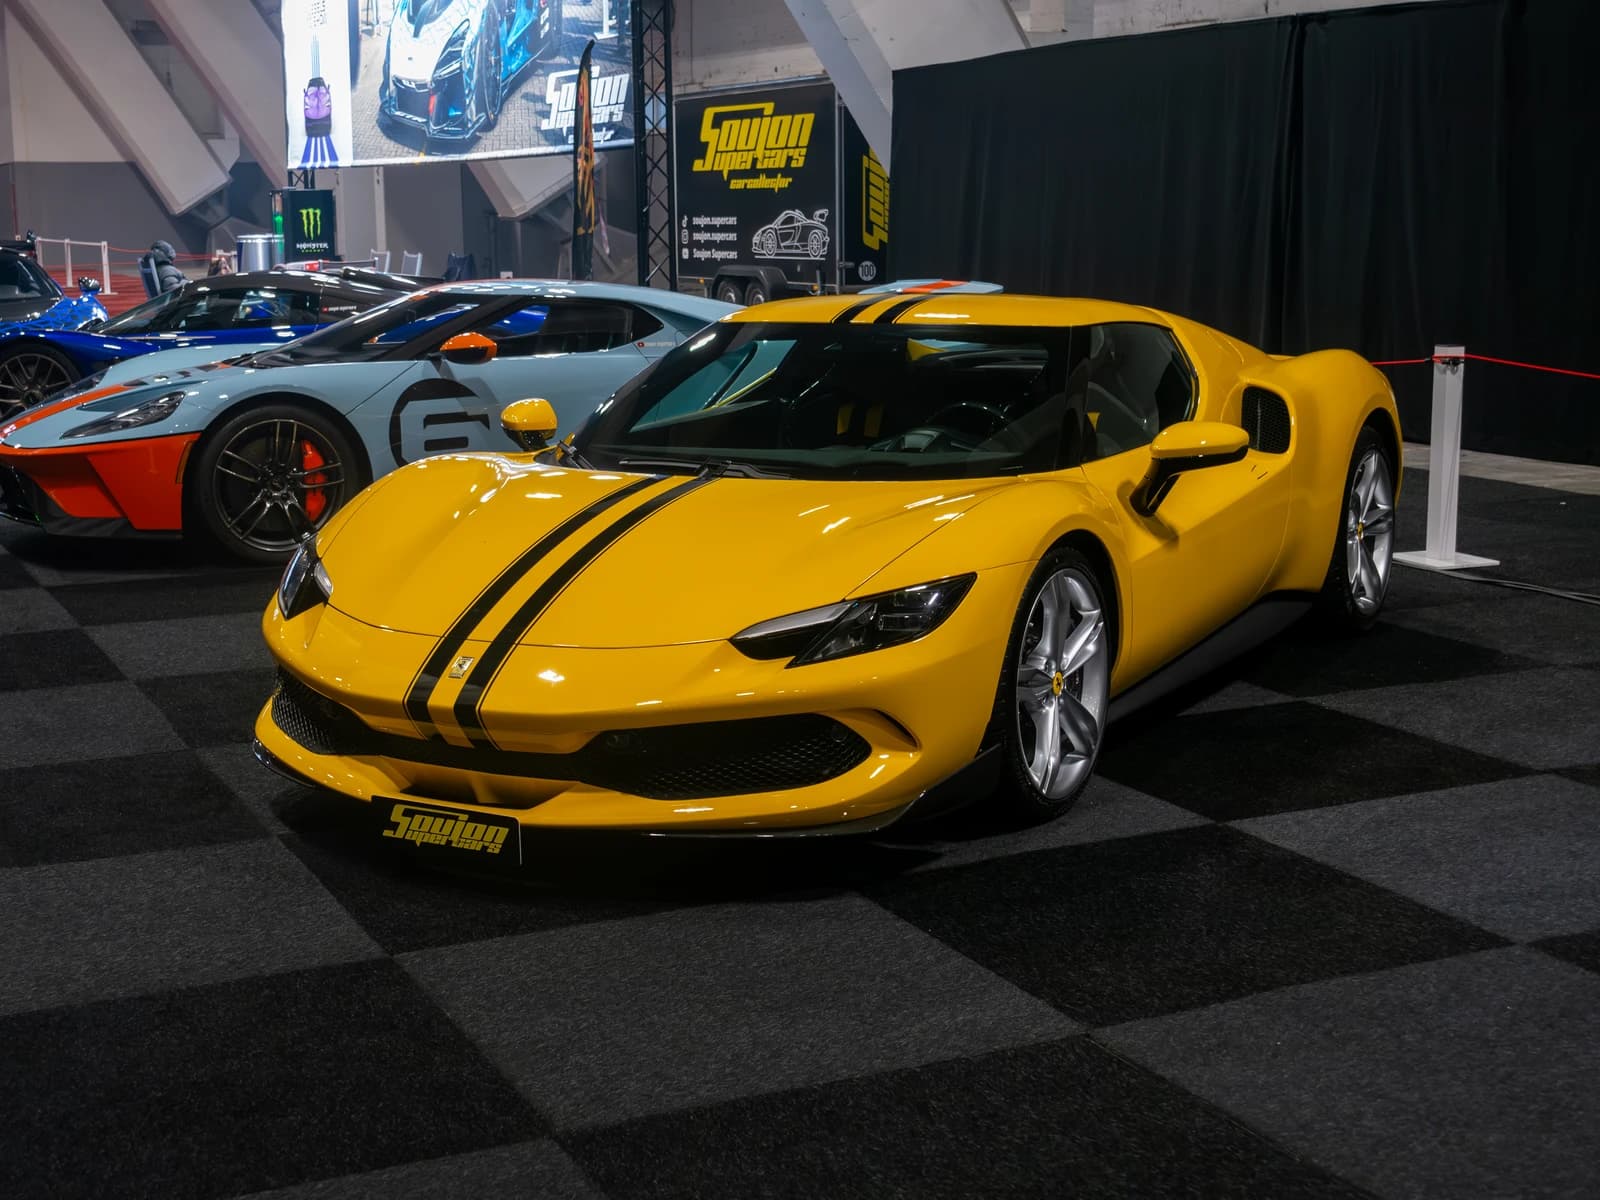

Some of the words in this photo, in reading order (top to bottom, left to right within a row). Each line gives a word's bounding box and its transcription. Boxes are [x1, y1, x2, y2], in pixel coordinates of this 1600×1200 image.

[692, 102, 815, 171] Soujon
[693, 248, 711, 261] Soujon
[712, 248, 738, 261] Supercars
[861, 264, 876, 278] 100
[382, 804, 509, 844] Soujon
